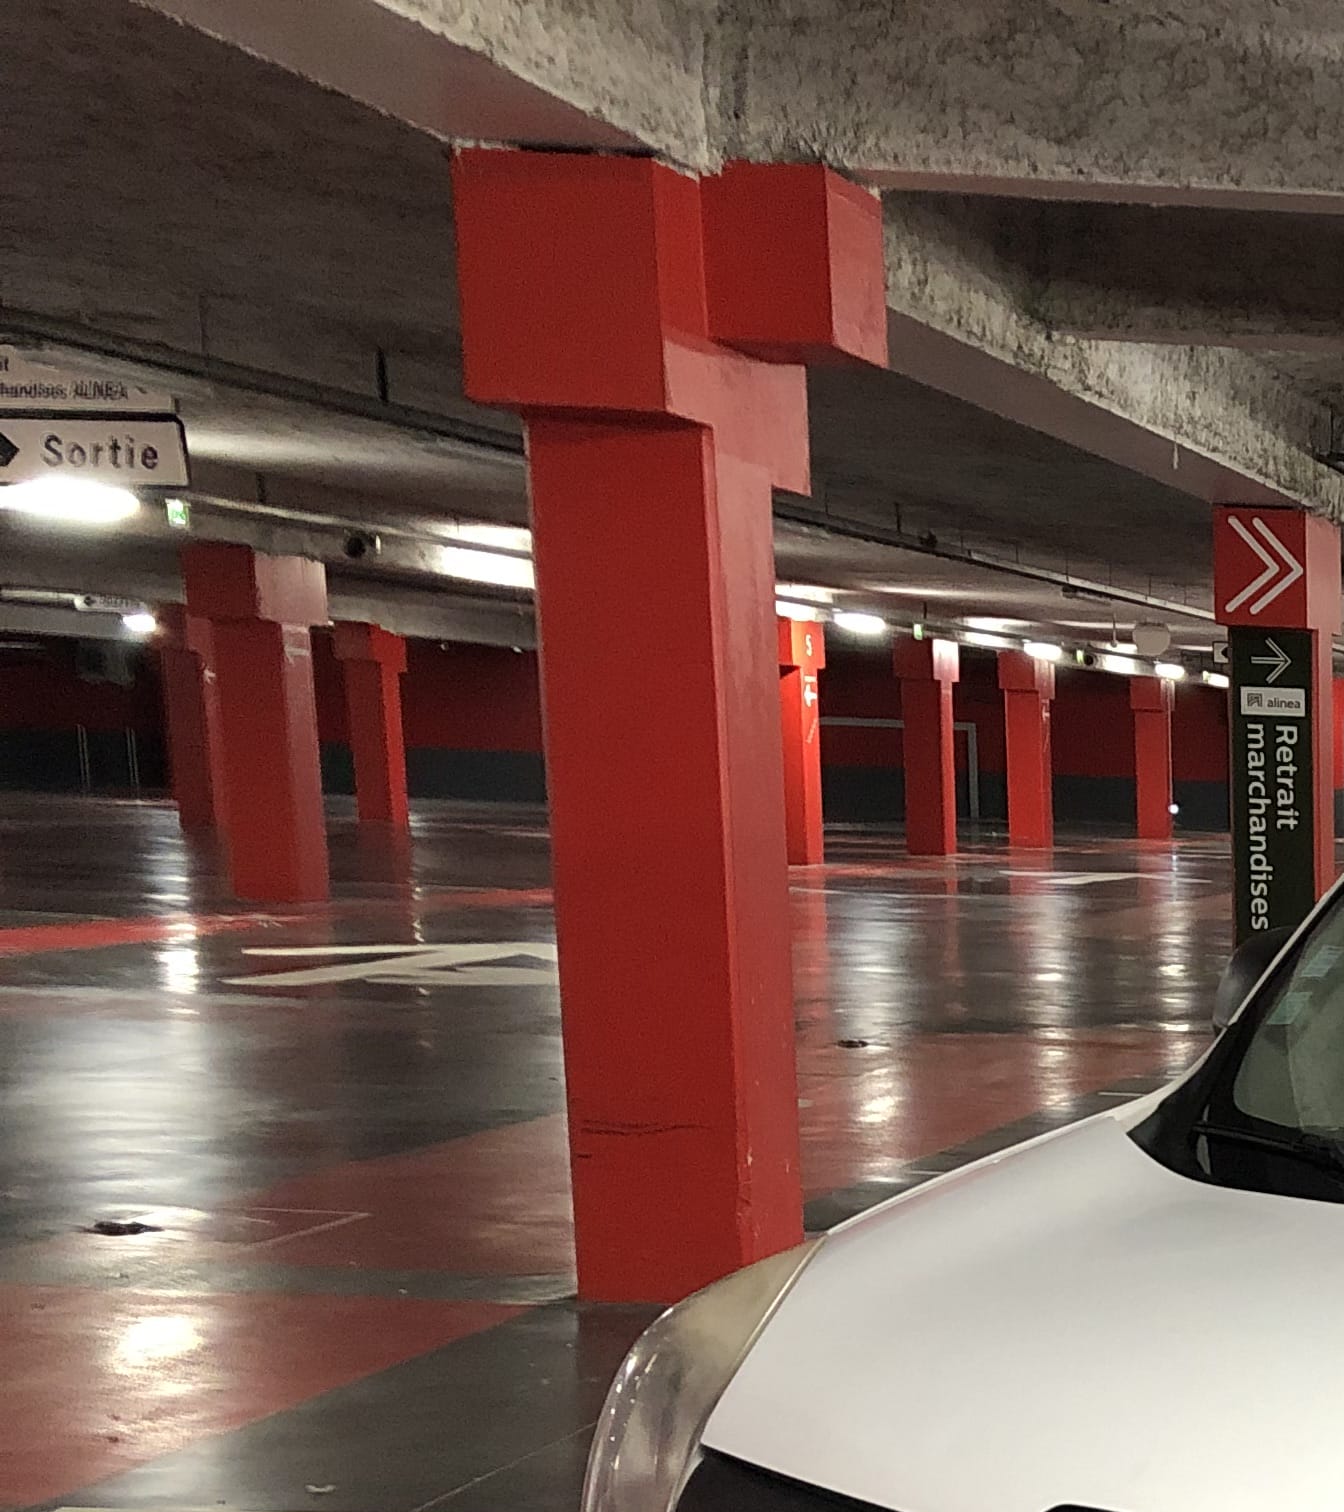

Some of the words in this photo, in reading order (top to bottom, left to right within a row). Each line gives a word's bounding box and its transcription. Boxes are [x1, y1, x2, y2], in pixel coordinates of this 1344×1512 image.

[42, 433, 159, 470] Sortie
[1267, 697, 1301, 709] alinea
[1275, 724, 1299, 830] Retrait
[1246, 723, 1273, 930] marchandises
